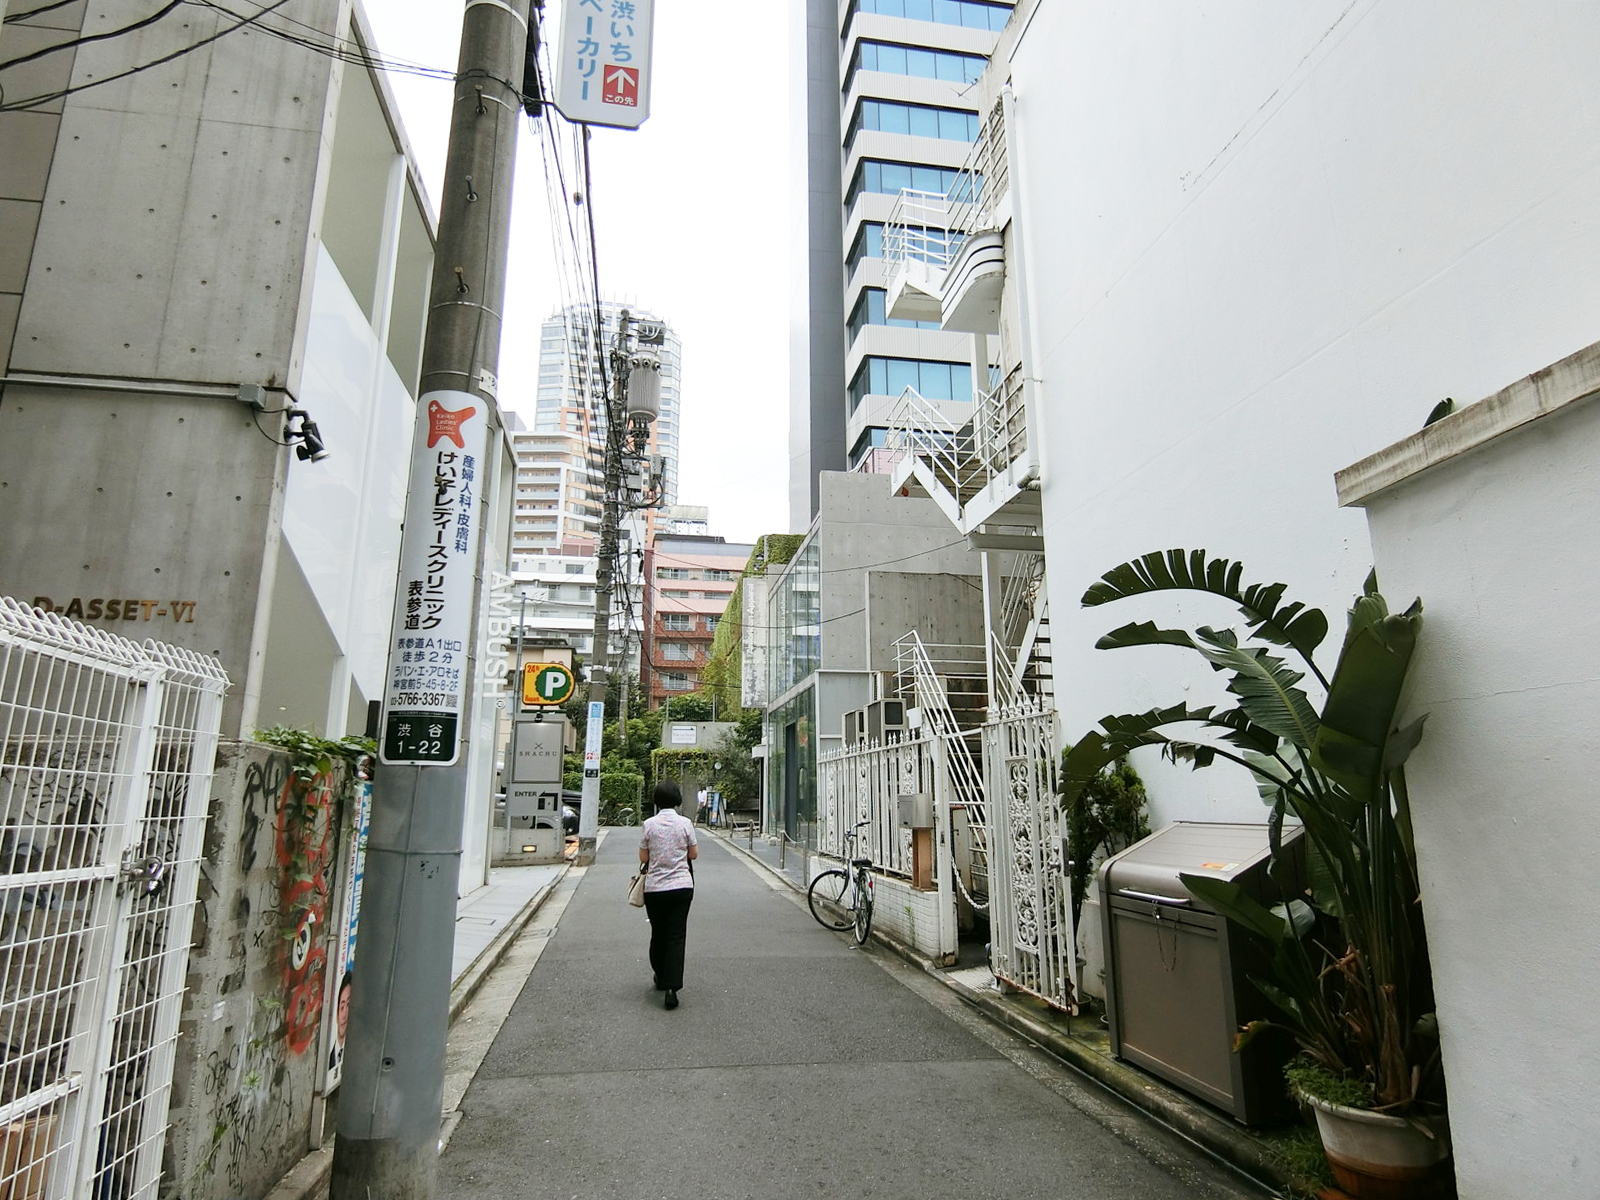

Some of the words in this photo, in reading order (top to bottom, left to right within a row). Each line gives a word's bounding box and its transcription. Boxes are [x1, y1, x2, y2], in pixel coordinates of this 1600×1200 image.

[610, 0, 635, 62] 渋いち
[605, 94, 634, 105] この先
[455, 454, 475, 555] 産婦人科・皮膚科
[404, 580, 424, 631] 表参道
[482, 571, 515, 698] AMBUSH
[545, 671, 567, 697] P
[397, 723, 443, 738] 渋谷
[397, 740, 441, 755] 1-22
